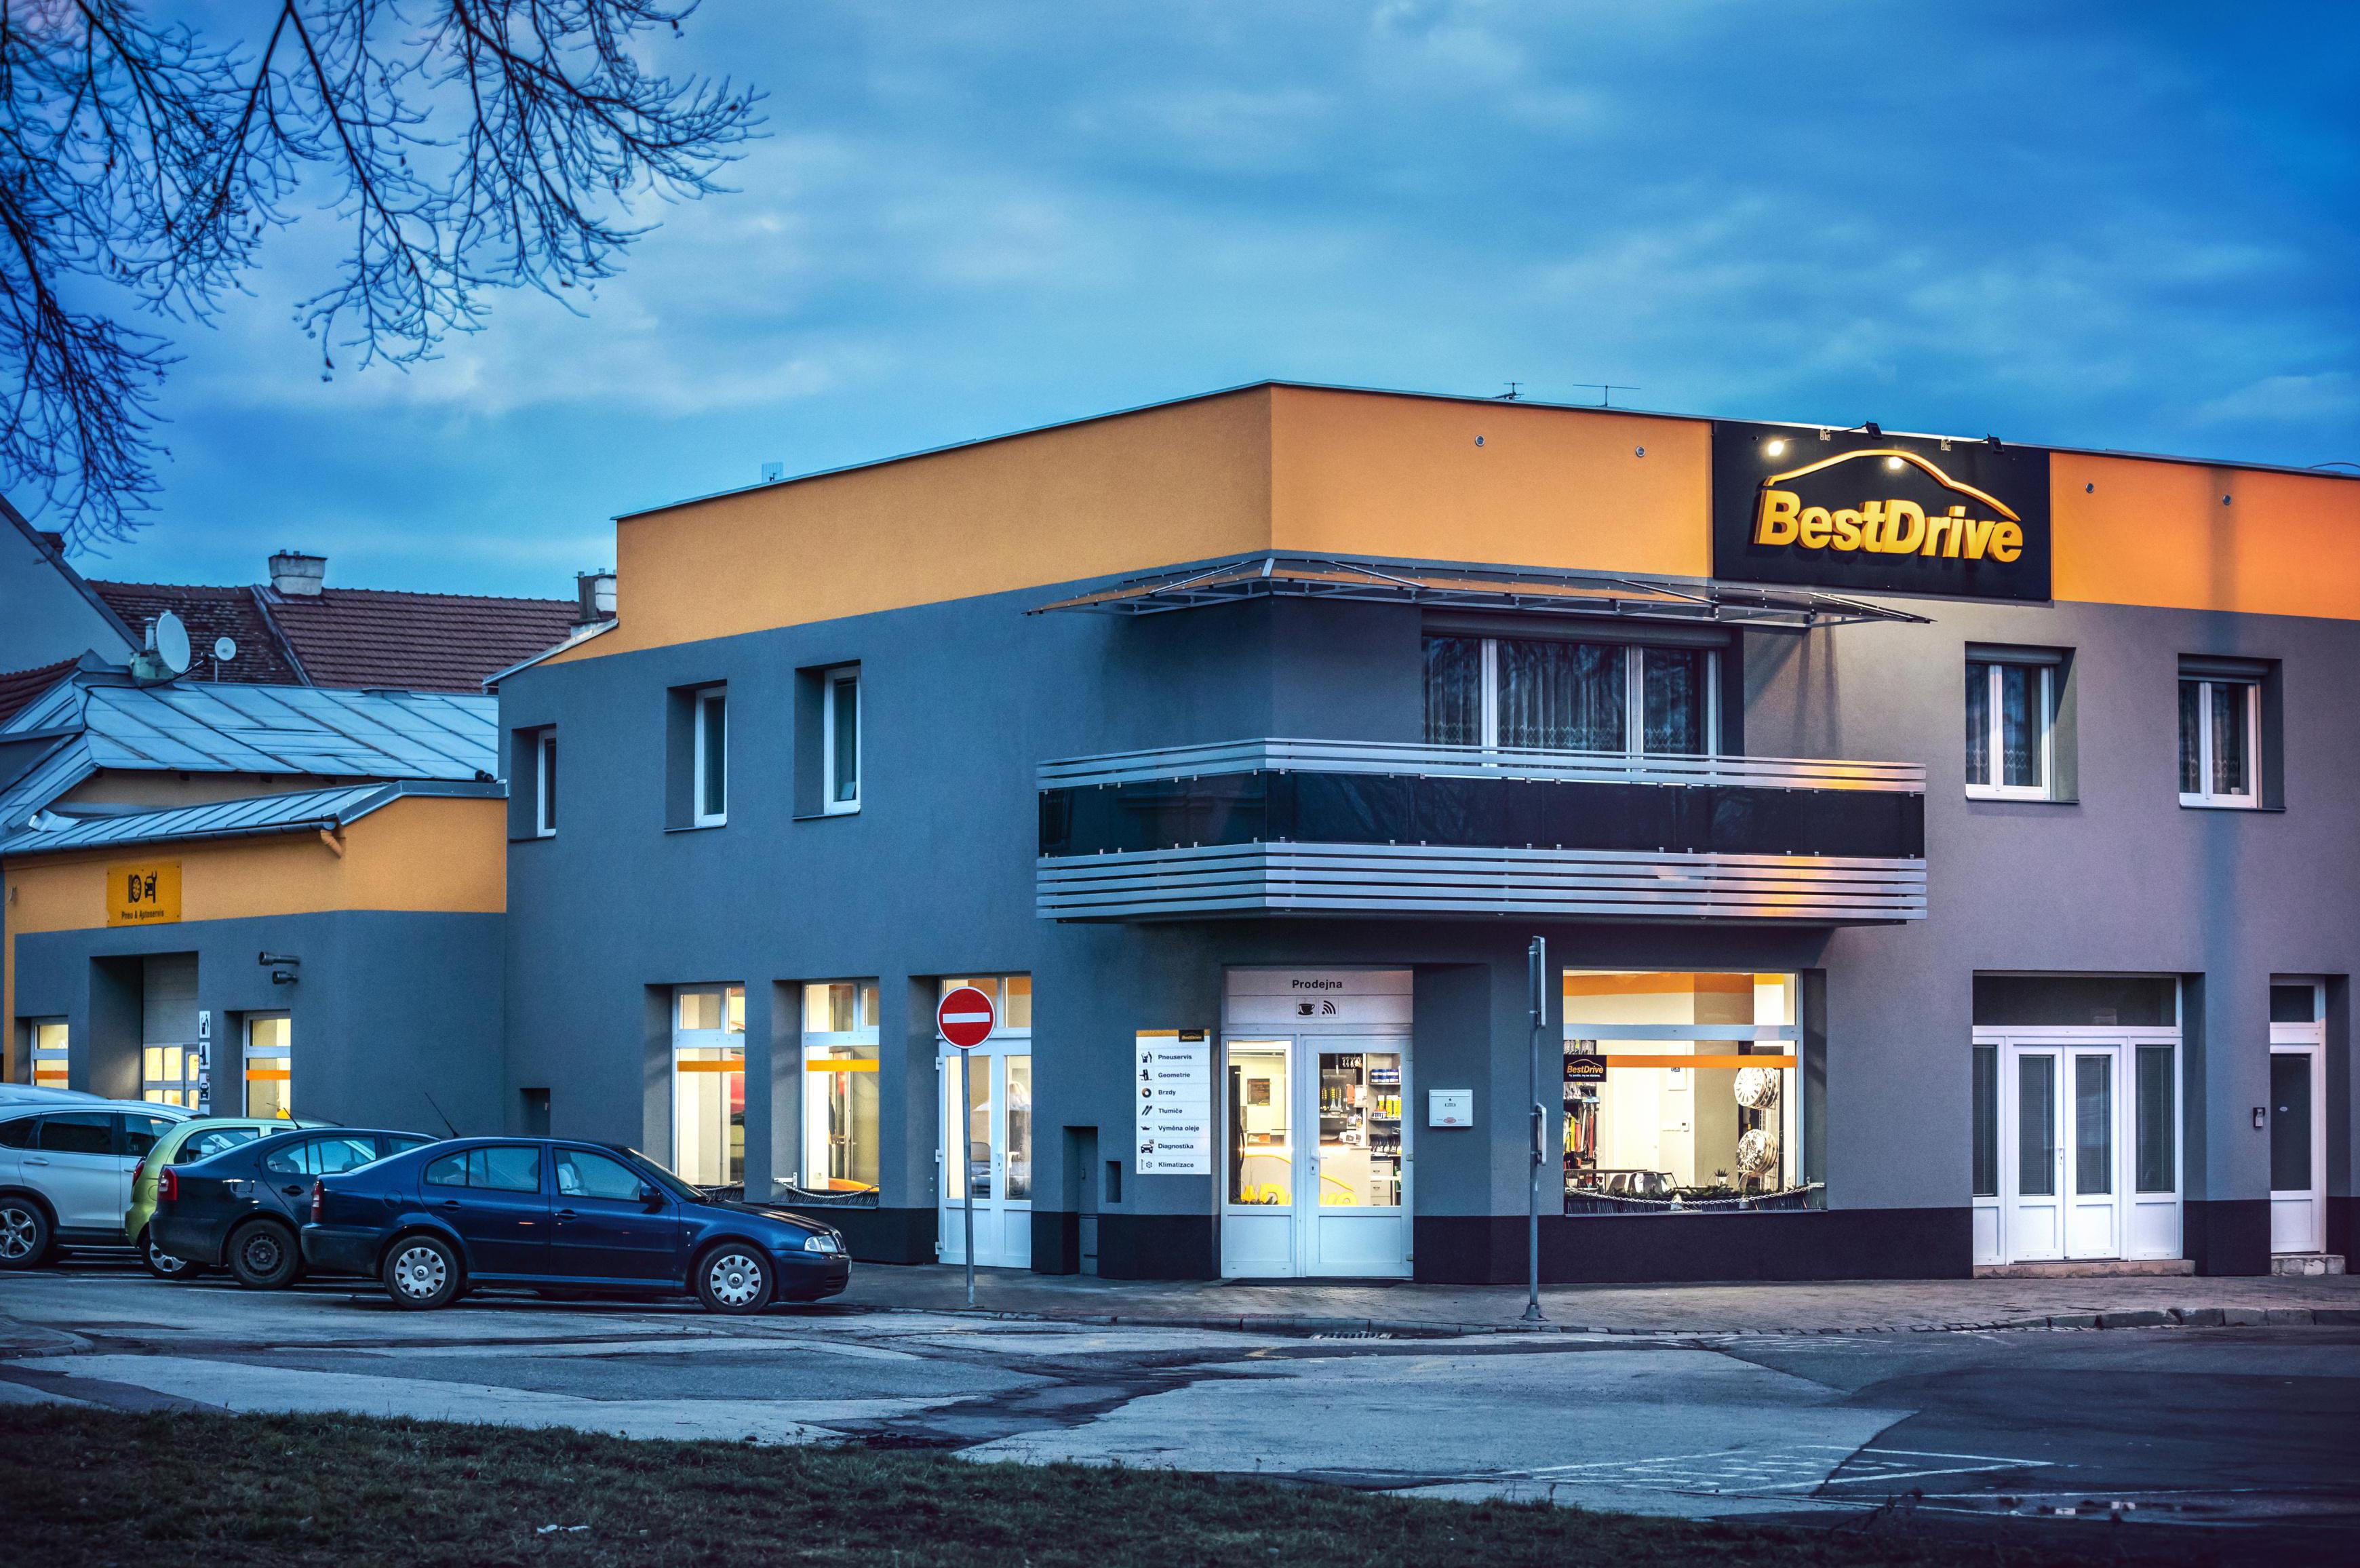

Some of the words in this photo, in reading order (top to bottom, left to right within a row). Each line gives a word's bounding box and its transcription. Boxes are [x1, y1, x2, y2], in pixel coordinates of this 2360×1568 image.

[1754, 489, 2023, 563] BestDrive
[1292, 979, 1343, 990] Prodejna
[1567, 1065, 1603, 1073] BestDrive
